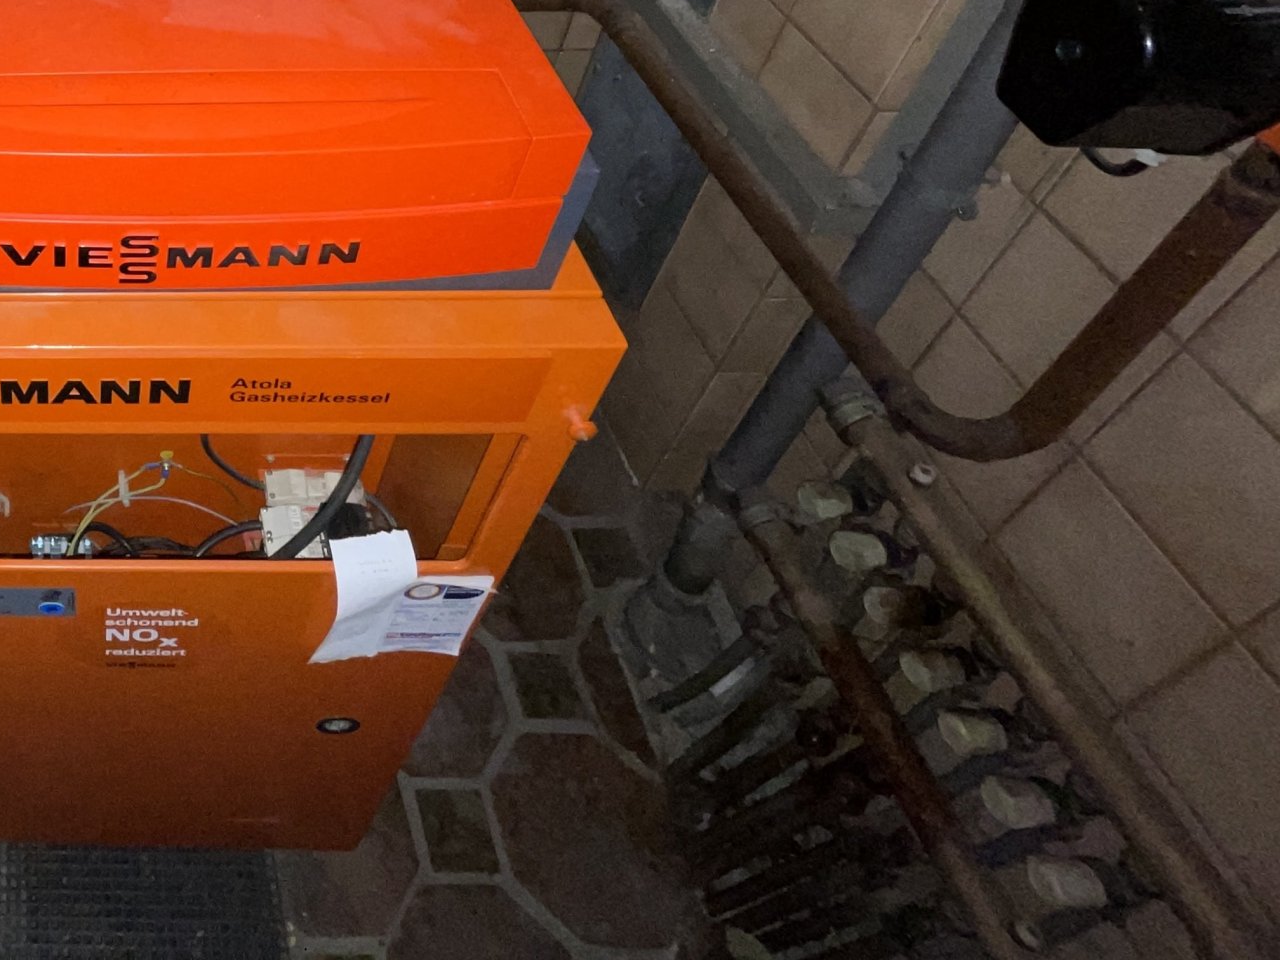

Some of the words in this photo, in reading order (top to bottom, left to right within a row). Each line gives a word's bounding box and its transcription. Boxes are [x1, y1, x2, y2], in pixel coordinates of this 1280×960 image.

[0, 235, 361, 284] VIESSMANN
[231, 378, 293, 389] Atola
[229, 391, 391, 403] Gasheizkessel
[106, 608, 189, 617] Umwelt-
[105, 618, 199, 627] schonend
[105, 648, 187, 657] reduziert
